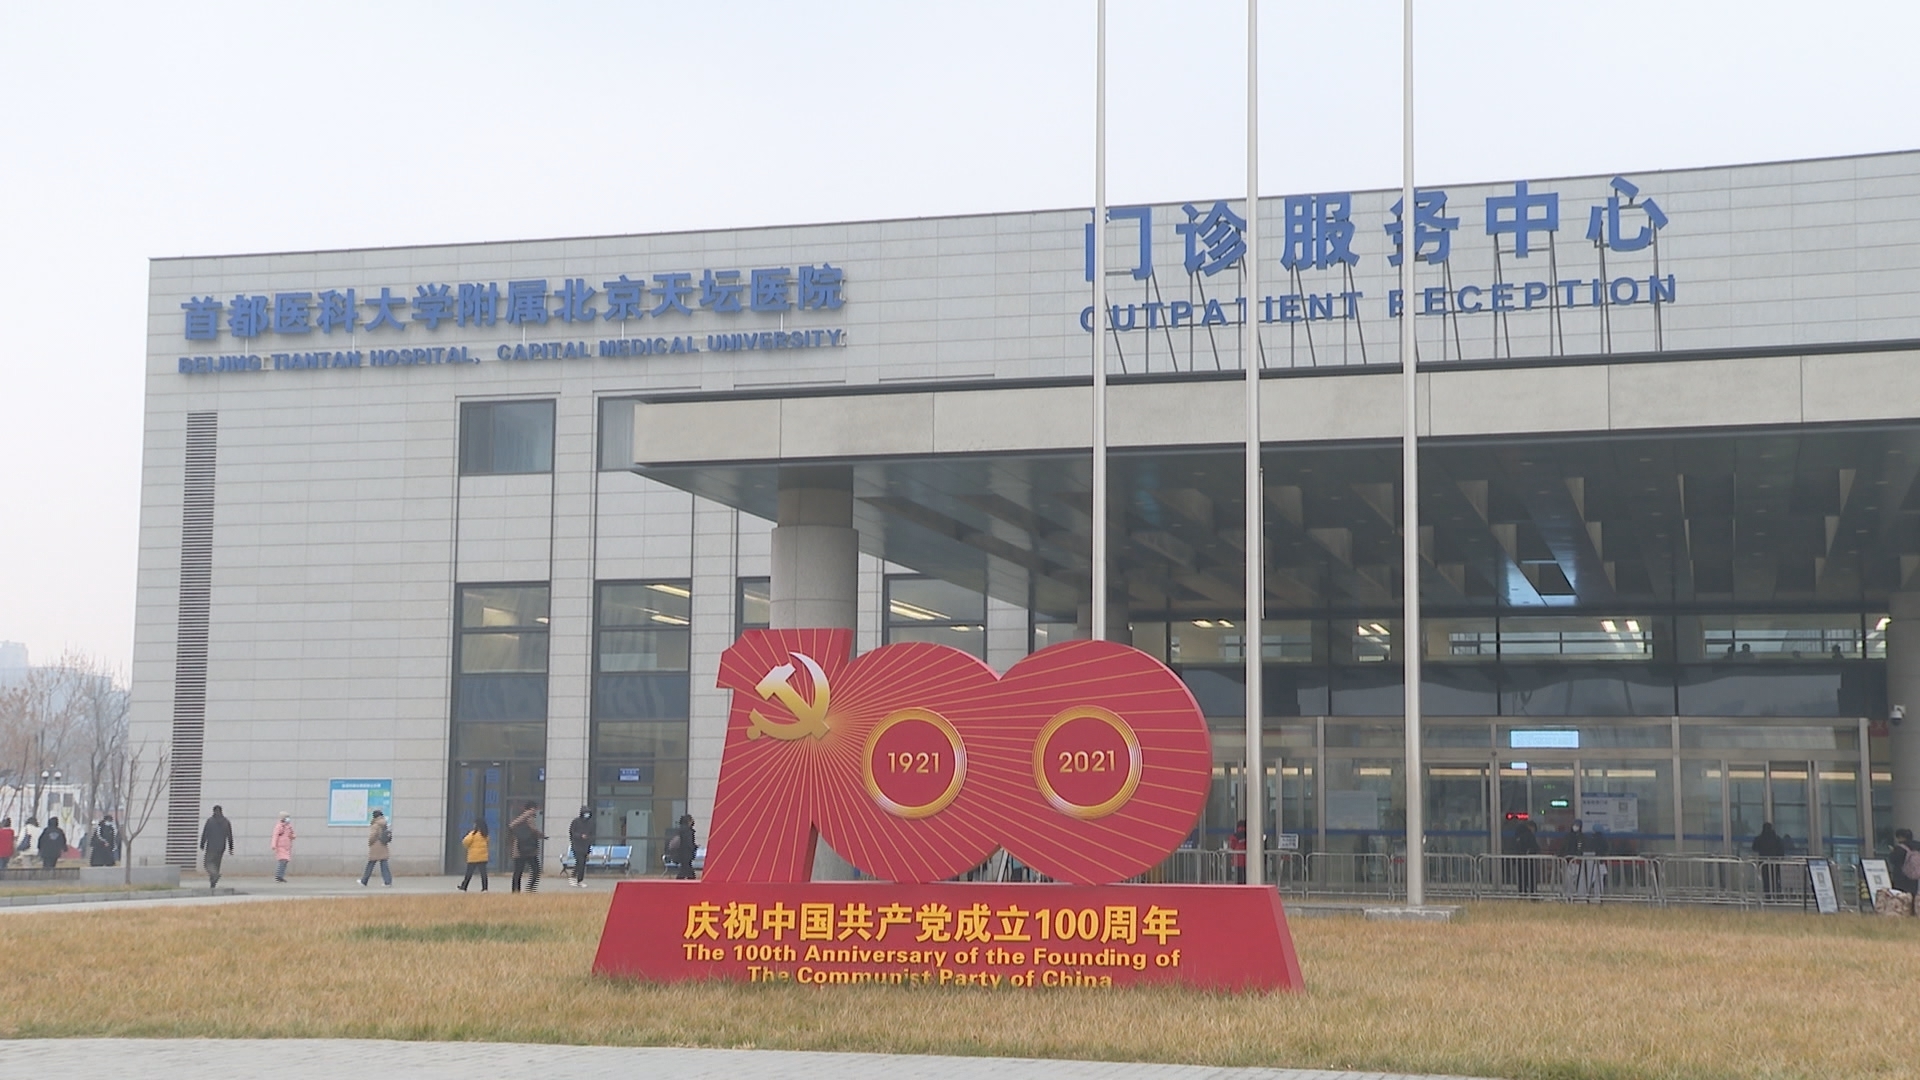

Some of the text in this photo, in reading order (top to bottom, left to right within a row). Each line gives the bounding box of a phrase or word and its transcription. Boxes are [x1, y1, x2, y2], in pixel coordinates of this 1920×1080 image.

[1085, 175, 1669, 281] 门诊服务中心
[181, 263, 843, 341] 首都医科大学附属北京天坛医院
[1388, 274, 1676, 318] RECEPTION
[178, 329, 842, 374] BEIJING TIANTAN HOSPITAL, CAPITAL MEDICAL UNIVERSITY
[887, 752, 940, 774] 1921
[1058, 749, 1116, 773] 2021
[683, 901, 1181, 945] 庆祝中国共产党成立100周年
[682, 944, 1181, 970] The 100th Anniversary of the Founding of
[747, 966, 1113, 989] The Communist Party of China
